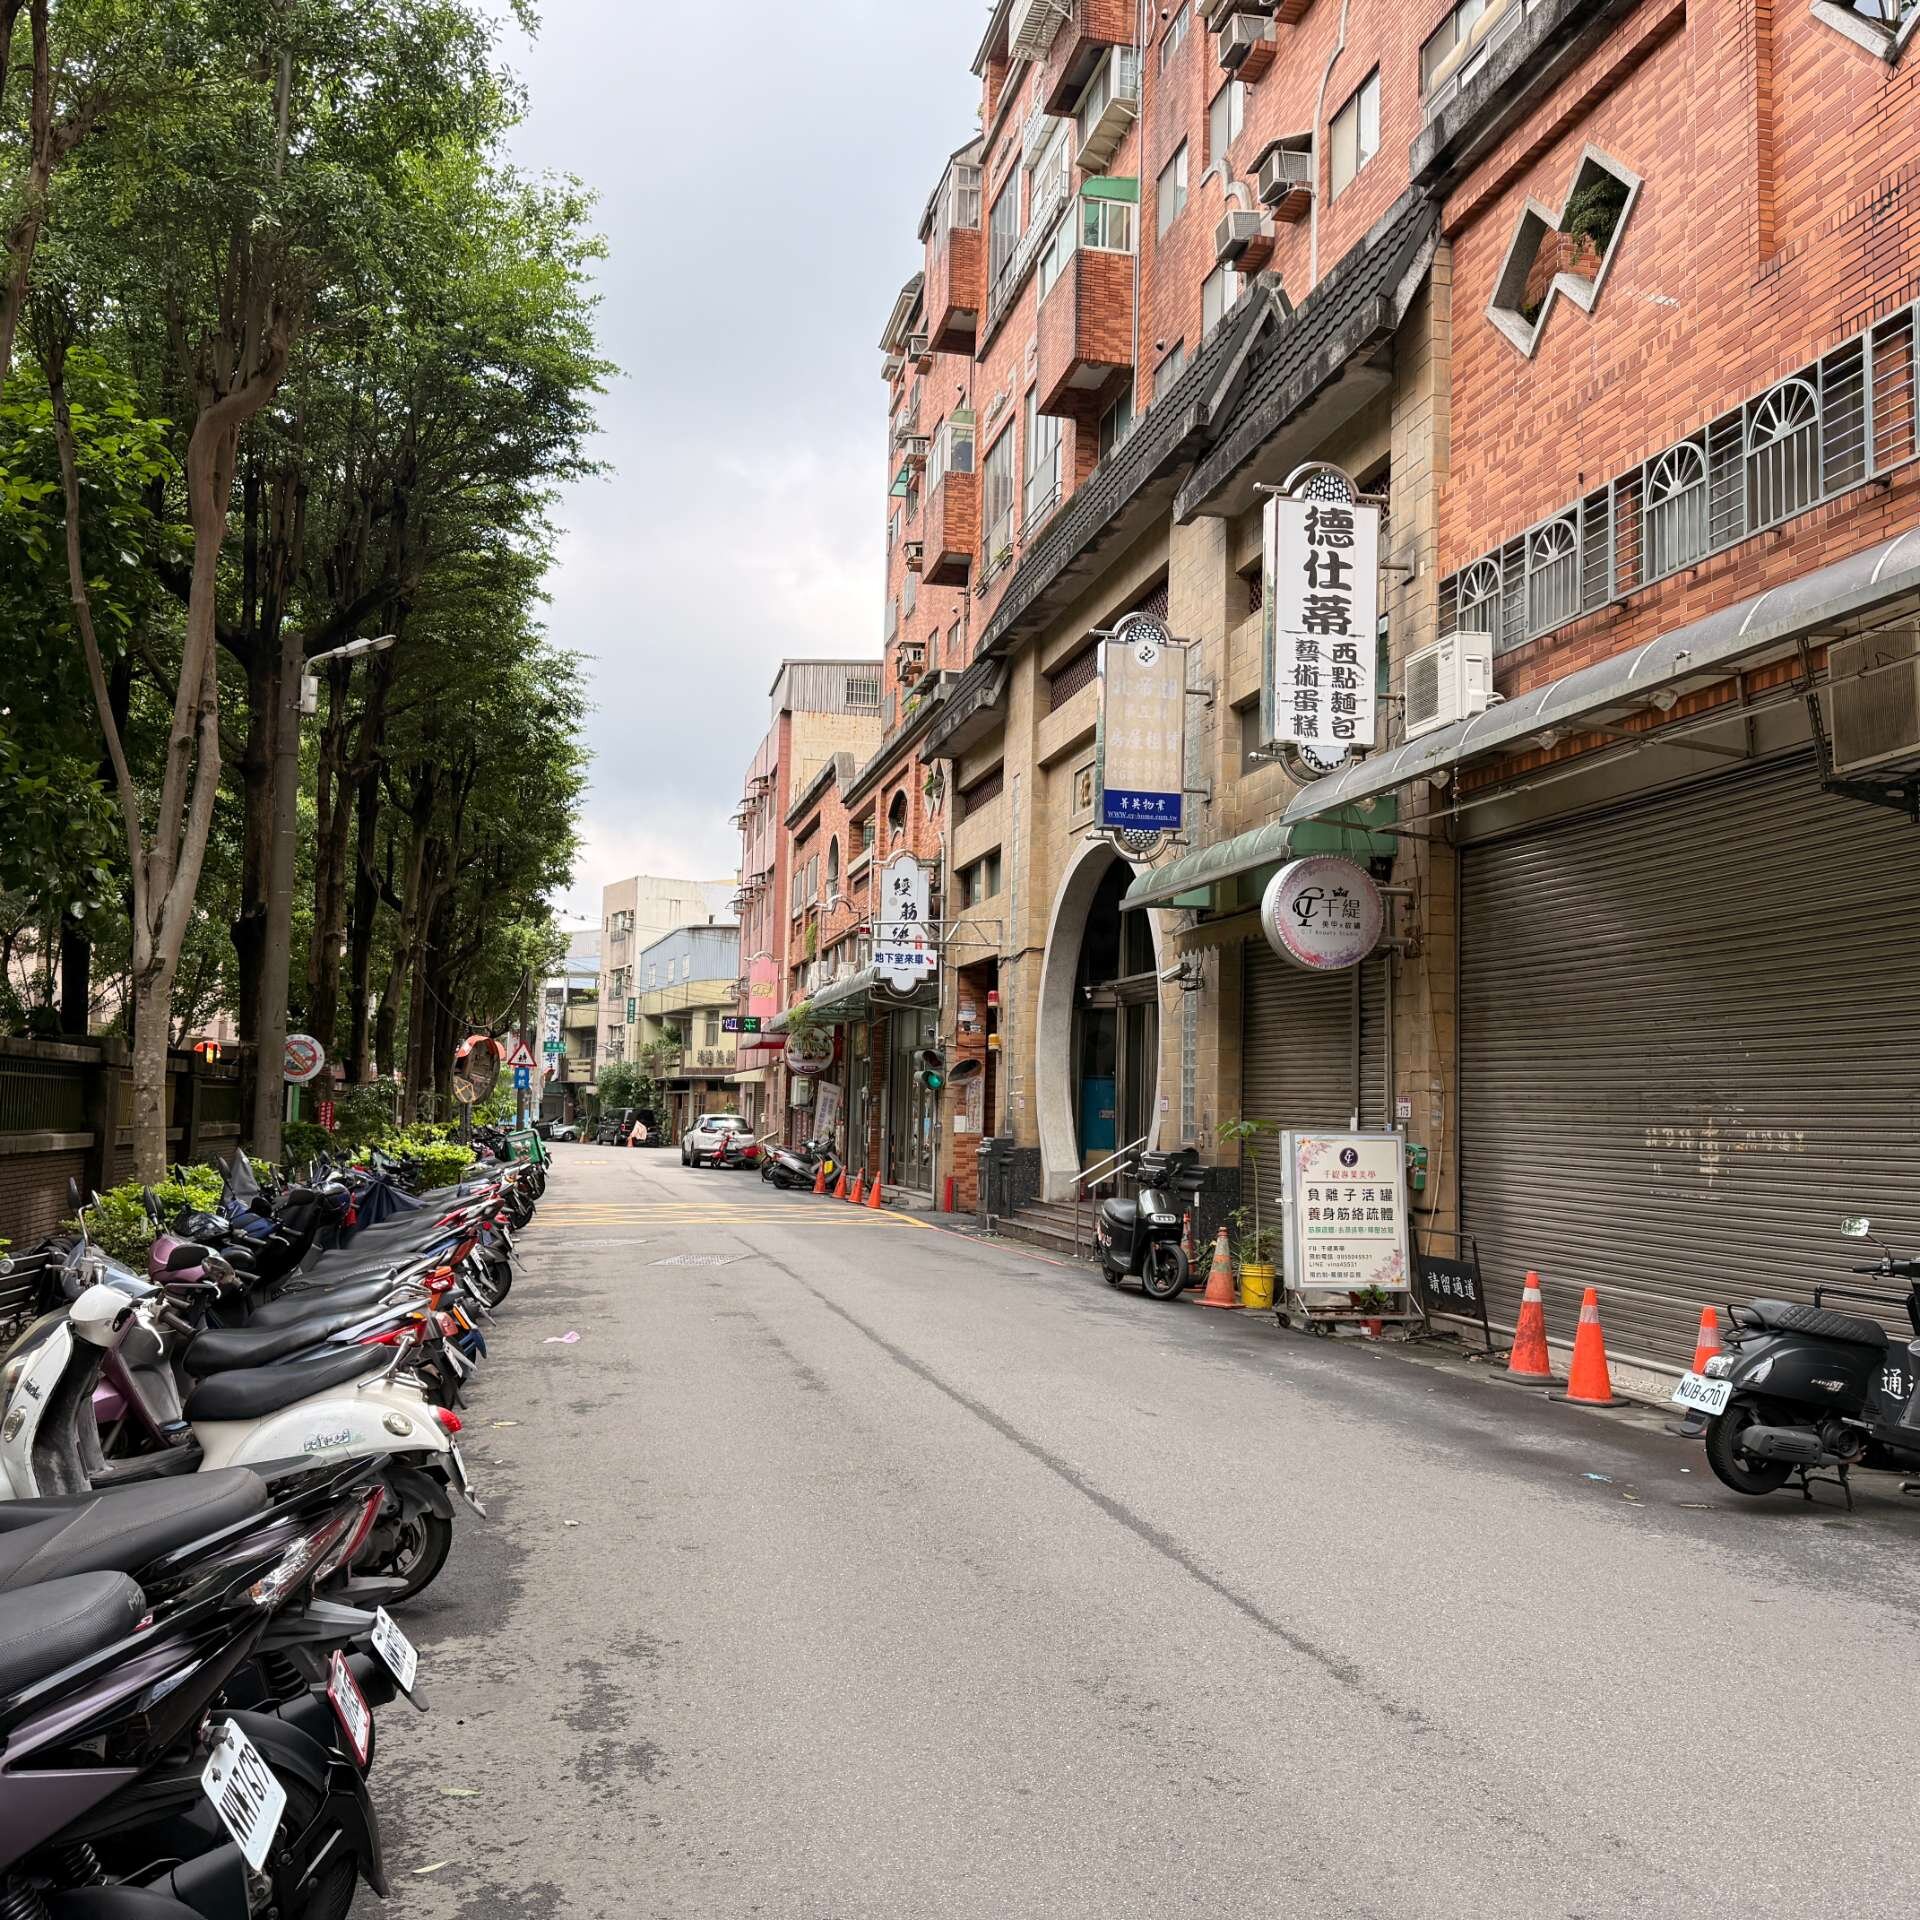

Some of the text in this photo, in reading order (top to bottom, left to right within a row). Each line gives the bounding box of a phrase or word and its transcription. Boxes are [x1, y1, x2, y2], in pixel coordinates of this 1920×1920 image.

[1302, 505, 1355, 636] 德仕蒂
[1292, 638, 1320, 738] 藝術蛋糕
[1330, 642, 1357, 739] 西點麵包
[1120, 797, 1166, 811] 菁英物業
[1320, 898, 1361, 919] 千緹
[875, 952, 924, 964] 地下室來車
[1427, 1271, 1476, 1300] 請留通道
